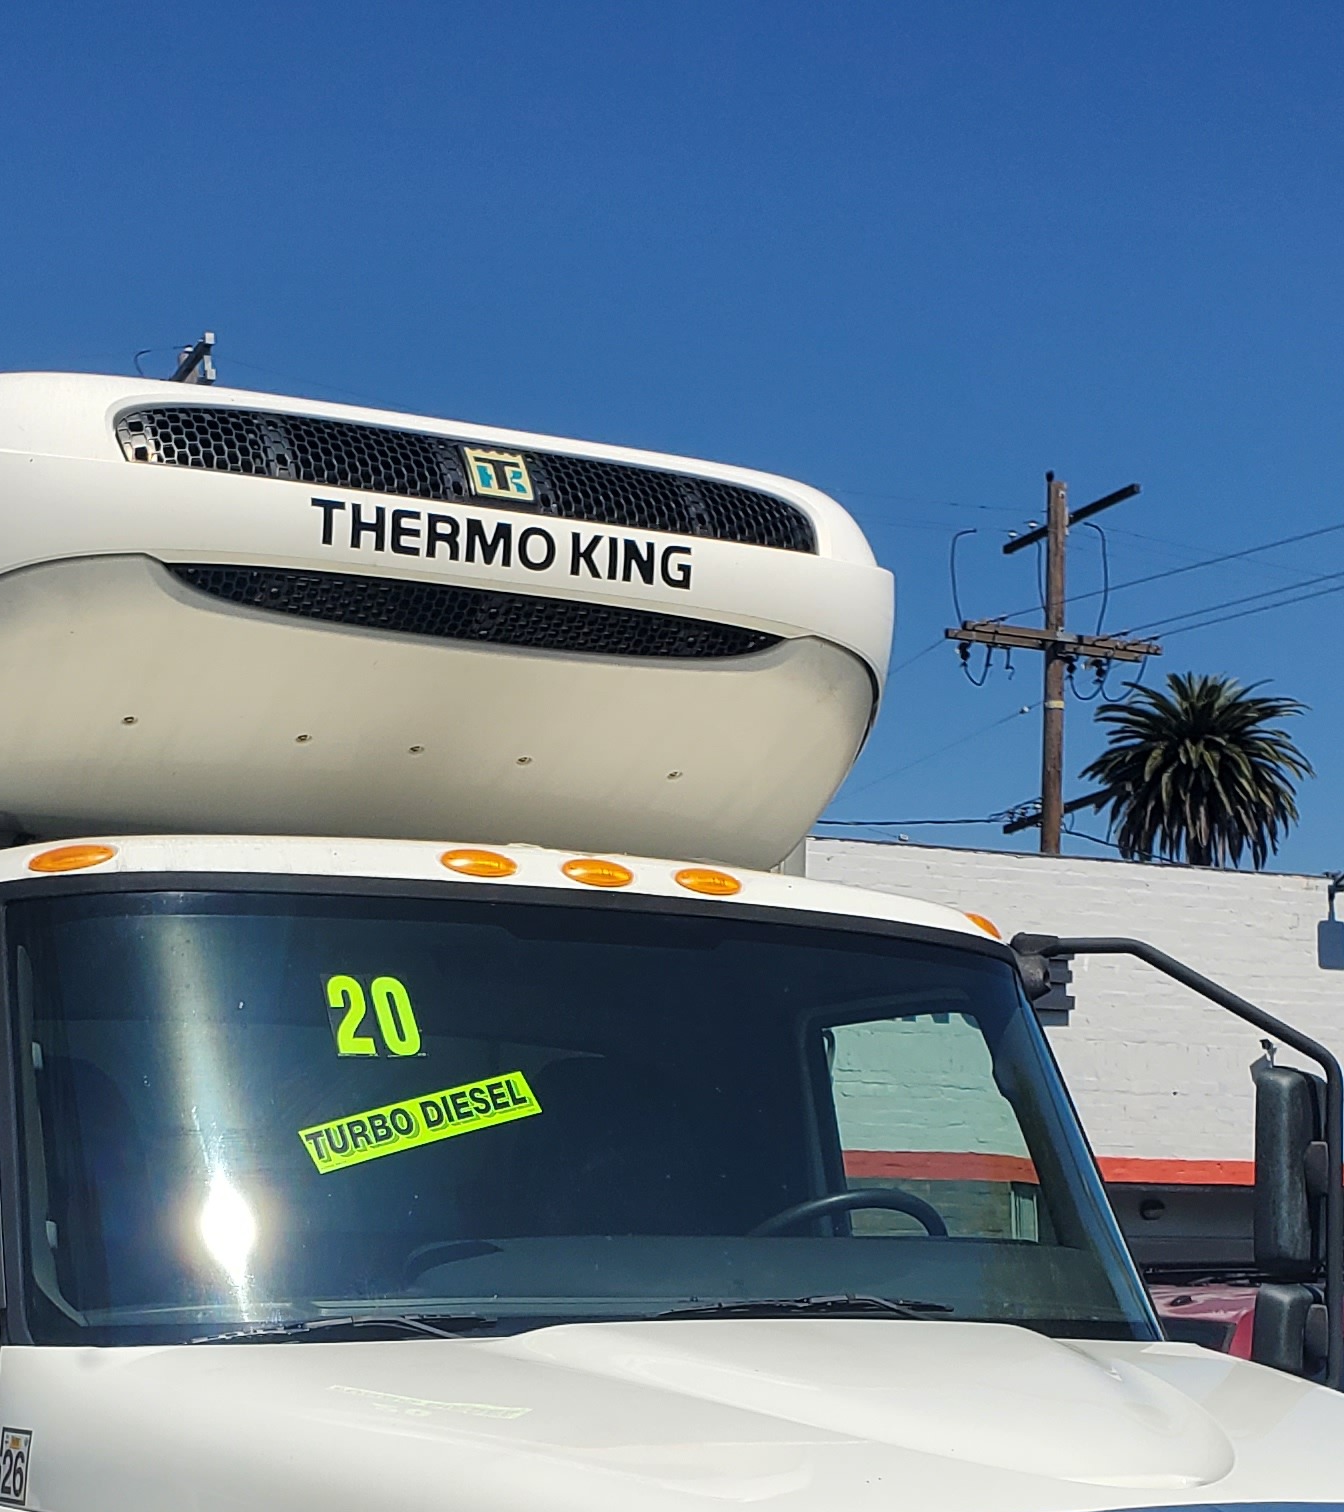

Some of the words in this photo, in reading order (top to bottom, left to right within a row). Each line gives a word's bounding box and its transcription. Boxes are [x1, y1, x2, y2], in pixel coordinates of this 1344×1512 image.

[310, 497, 556, 571] THERMO
[570, 531, 693, 590] KING
[327, 975, 421, 1056] 20
[306, 1108, 419, 1162] TURBO
[419, 1079, 533, 1132] DIESEL
[1, 1450, 25, 1498] 26
